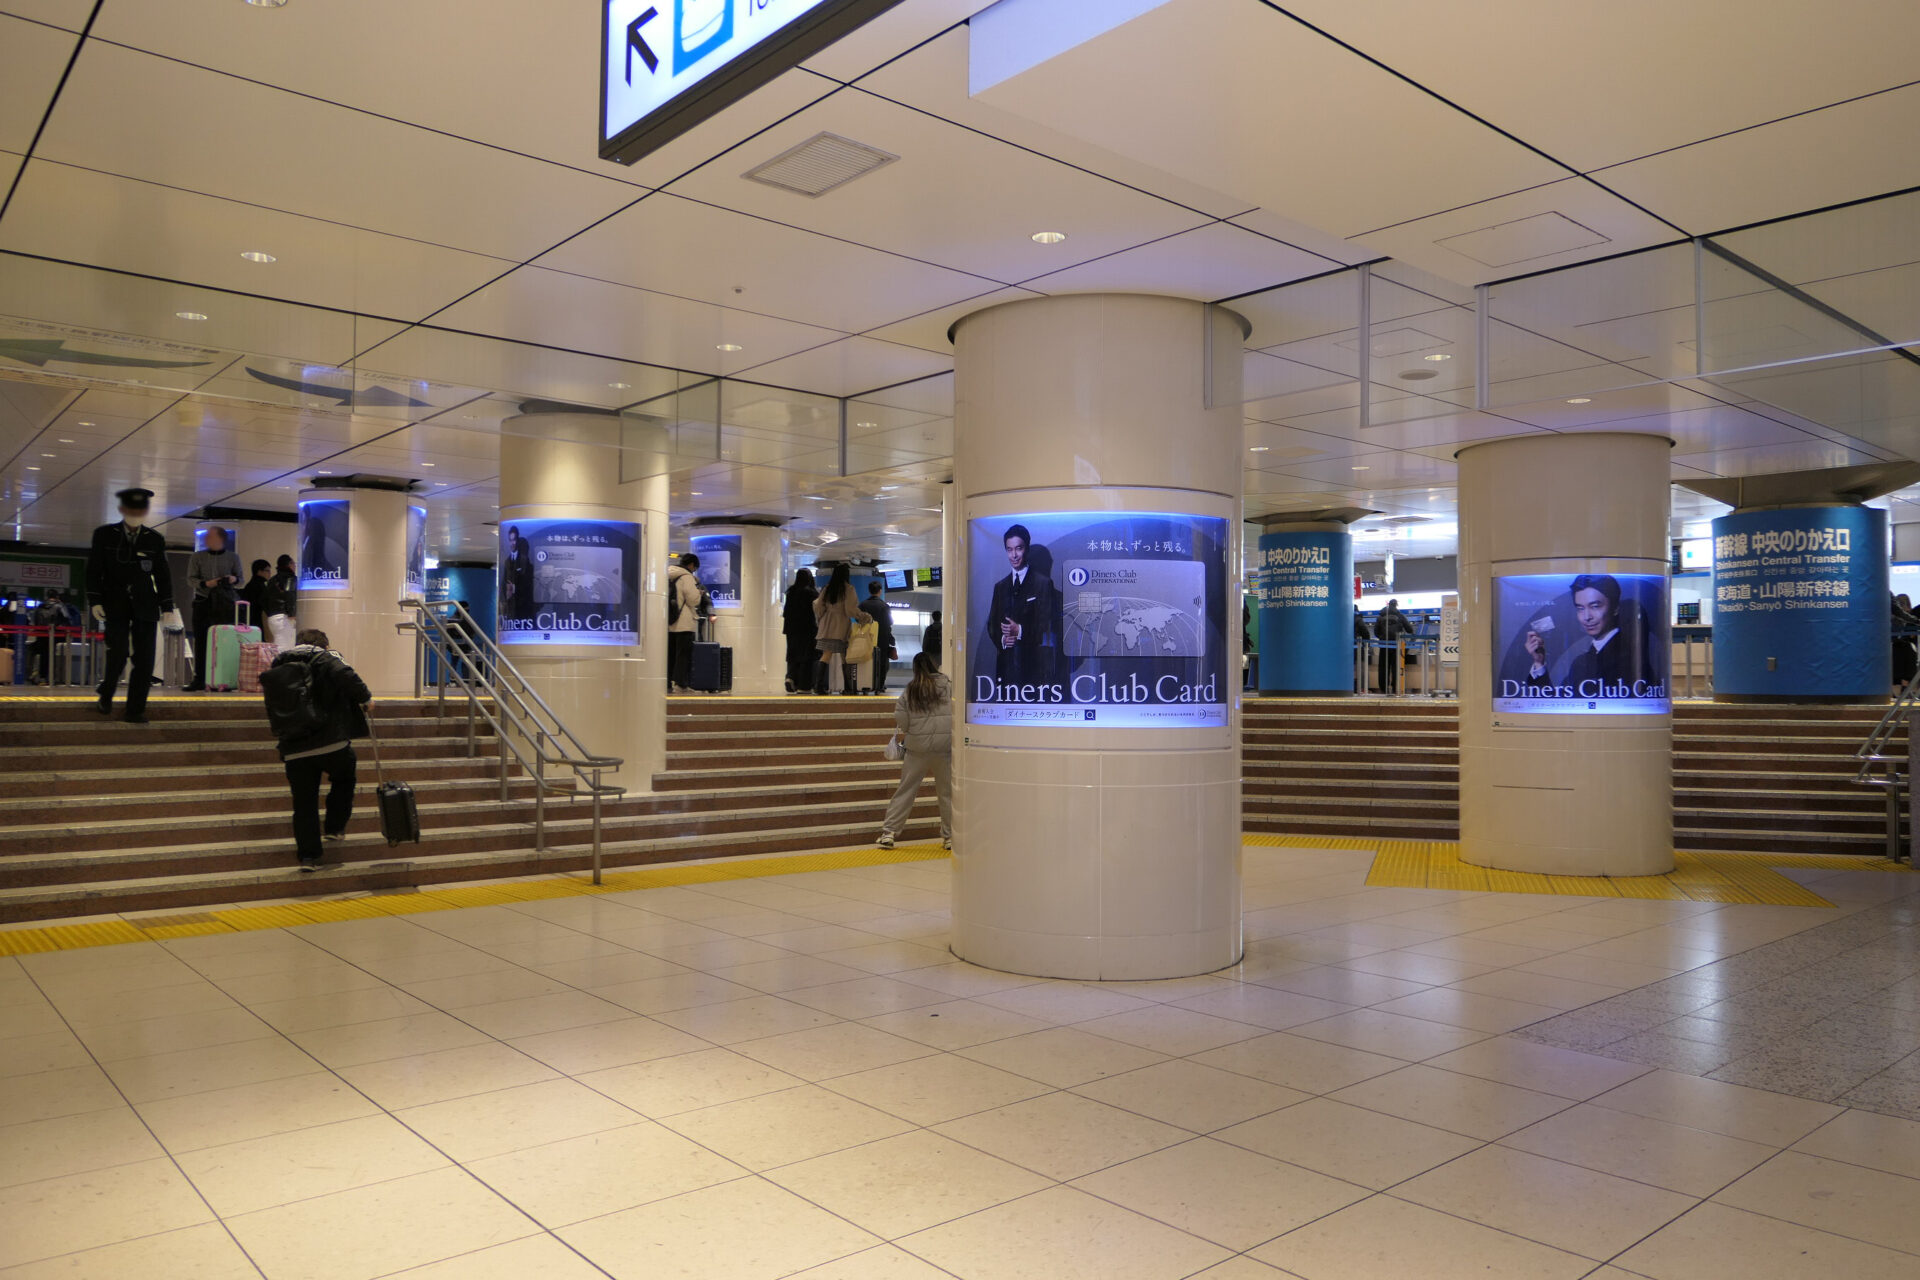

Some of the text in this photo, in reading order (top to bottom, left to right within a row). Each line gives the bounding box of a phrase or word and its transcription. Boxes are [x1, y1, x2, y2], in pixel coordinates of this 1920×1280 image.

[1087, 539, 1187, 553] 本物は、ずっと残る。
[1716, 527, 1851, 559] 新幹線 中央のりかえ口
[1268, 546, 1330, 567] 中央のりかえ口
[1716, 553, 1851, 571] Shinkansen Central Transfer
[313, 566, 341, 580] Card
[1091, 569, 1137, 578] Diners Club
[1272, 566, 1297, 575] Central
[1298, 565, 1330, 574] Transfer
[710, 589, 736, 600] Card
[1285, 599, 1328, 607] Shinkansen
[1785, 600, 1849, 609] Shinkansen
[536, 612, 582, 631] Club
[585, 613, 631, 631] Card
[975, 672, 1217, 703] Diners Club Card
[1502, 678, 1666, 698] Diners Club Card
[1007, 710, 1080, 719] ダイナースクラブカード
